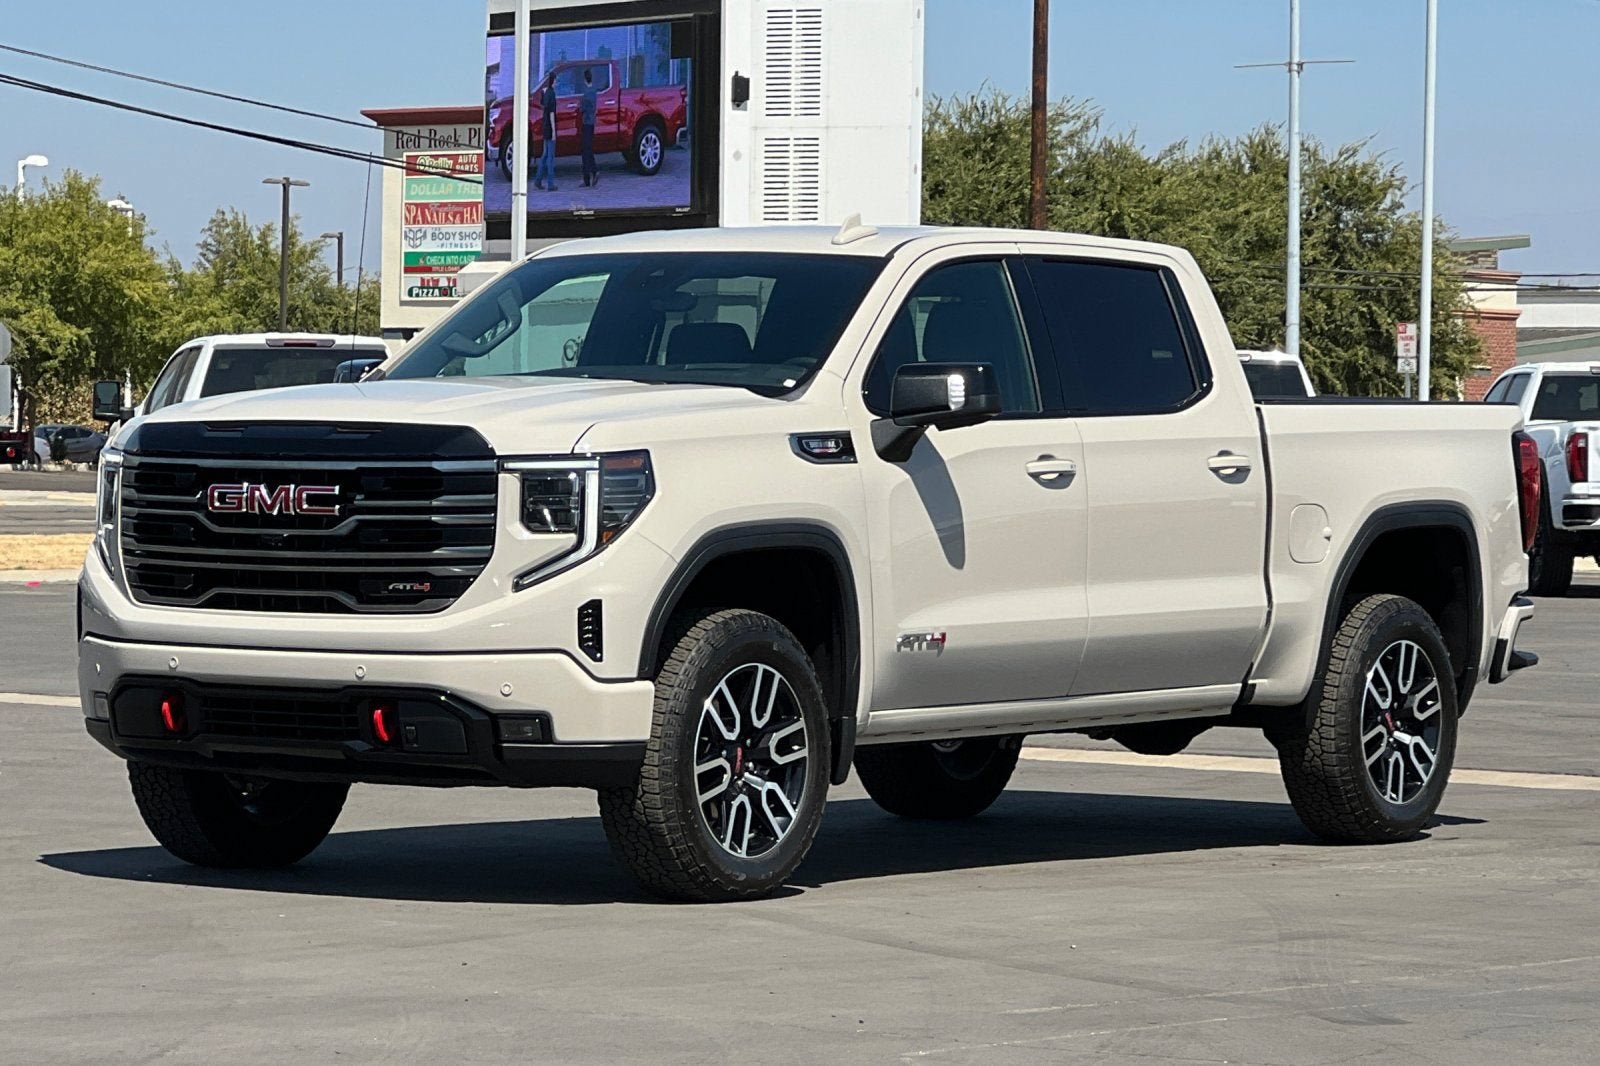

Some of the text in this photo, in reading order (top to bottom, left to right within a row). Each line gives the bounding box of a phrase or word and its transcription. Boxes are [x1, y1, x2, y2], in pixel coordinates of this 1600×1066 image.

[395, 127, 484, 149] Red Rock Pl
[458, 155, 477, 163] AUTO
[410, 184, 453, 195] DOLLAR
[404, 204, 422, 224] SPA
[425, 208, 453, 224] NAILS
[431, 232, 457, 240] BODY
[426, 256, 445, 265] CHECK
[446, 255, 459, 264] INTO
[412, 288, 440, 297] PIZZA
[207, 482, 340, 515] GMC
[896, 632, 947, 656] AT4
